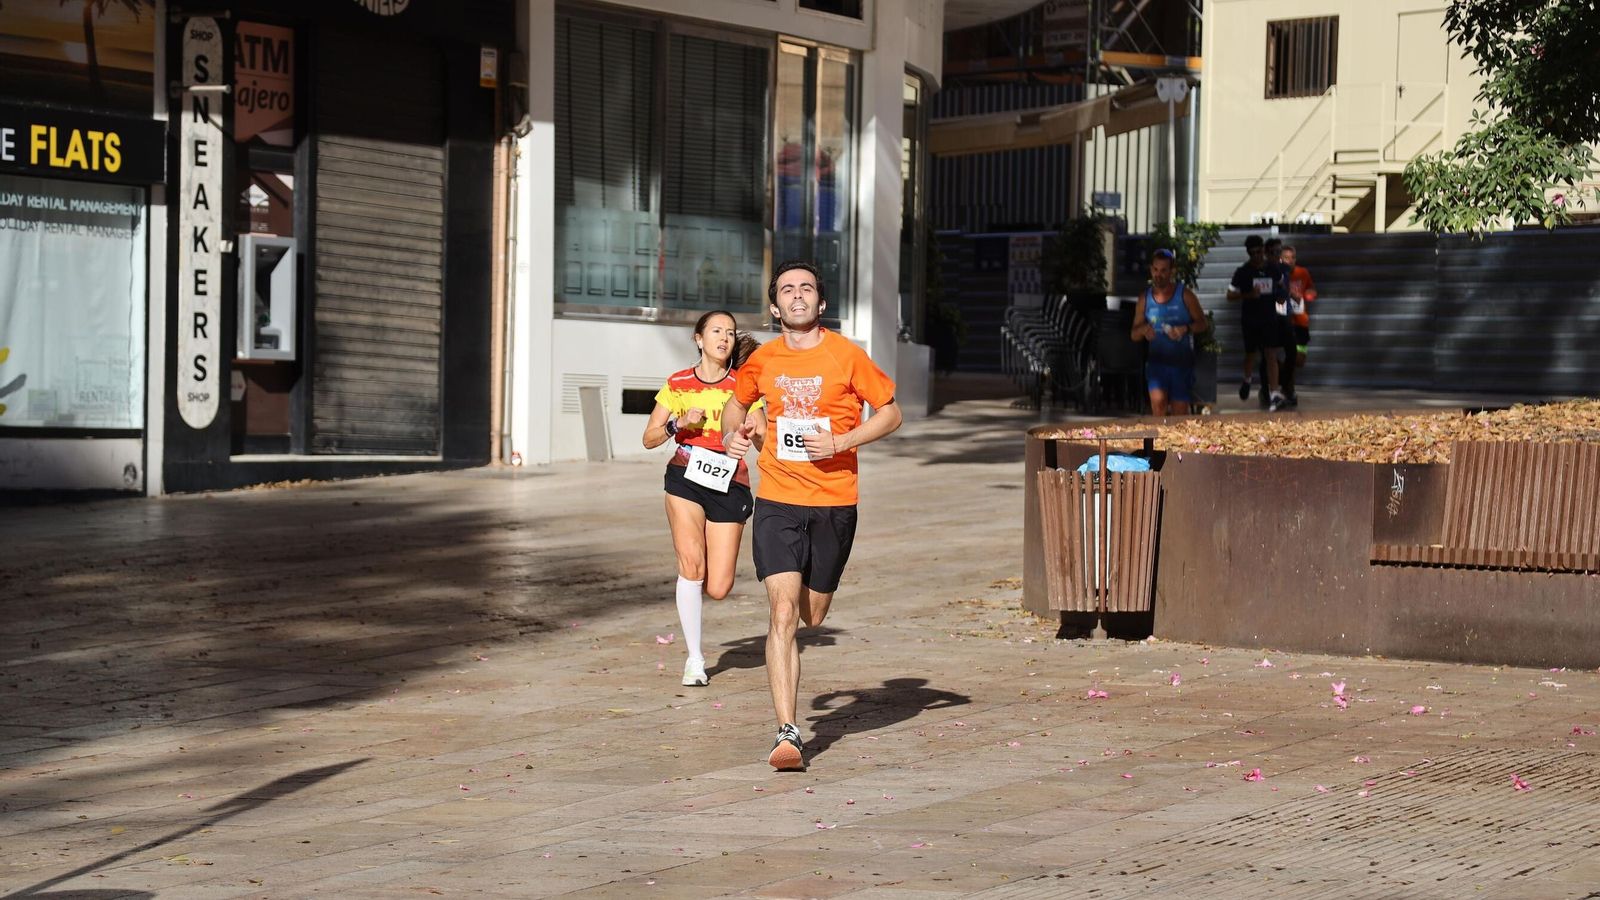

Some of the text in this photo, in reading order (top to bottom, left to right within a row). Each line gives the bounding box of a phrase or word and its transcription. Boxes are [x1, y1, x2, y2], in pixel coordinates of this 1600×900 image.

[190, 29, 213, 41] SHOP
[235, 33, 289, 75] ATM
[234, 80, 290, 115] ajero
[30, 124, 121, 173] FLATS
[27, 195, 68, 211] RENTAL
[193, 55, 210, 382] SNEAKERS
[187, 392, 210, 403] SHOP
[695, 459, 730, 479] 1027
